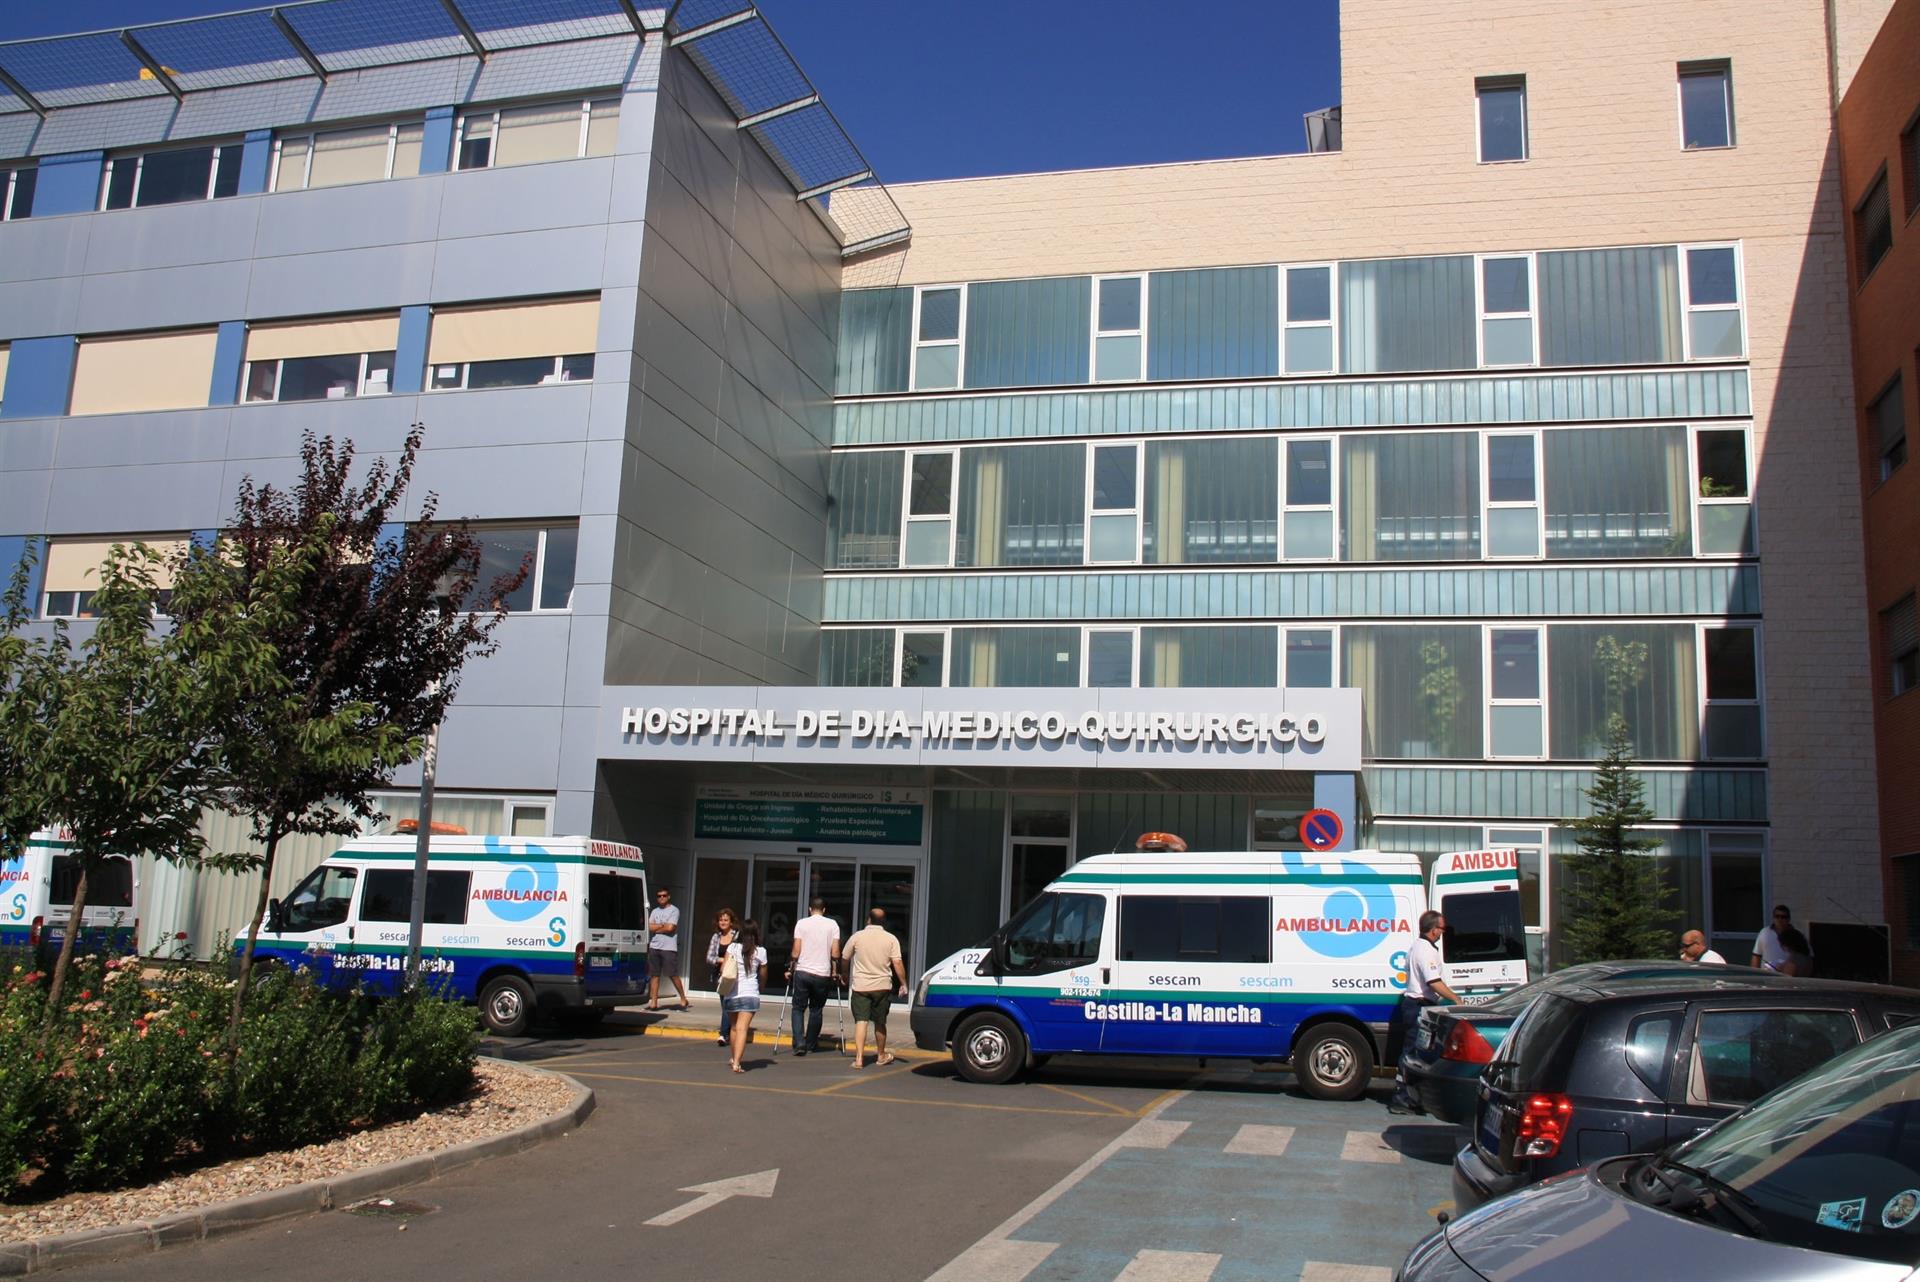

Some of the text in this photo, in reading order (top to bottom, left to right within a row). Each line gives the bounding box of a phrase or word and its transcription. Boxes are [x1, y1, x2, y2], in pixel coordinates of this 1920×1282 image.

[621, 707, 1328, 743] HOSPITAL DE DIA MEDICO-QUIRURGICO
[750, 790, 780, 798] HOSPITAL
[591, 842, 640, 861] AMBULANCIA
[471, 888, 568, 902] AMBULANCIA
[1276, 917, 1411, 933] AMBULANCIA
[442, 934, 481, 945] sescam
[507, 936, 546, 947] sescam
[962, 953, 981, 965] 122
[1148, 974, 1201, 987] sescam
[1239, 974, 1293, 988] sescam
[1332, 977, 1386, 989] sescam
[1084, 1001, 1183, 1022] Castilla-La
[1186, 1003, 1262, 1024] Mancha
